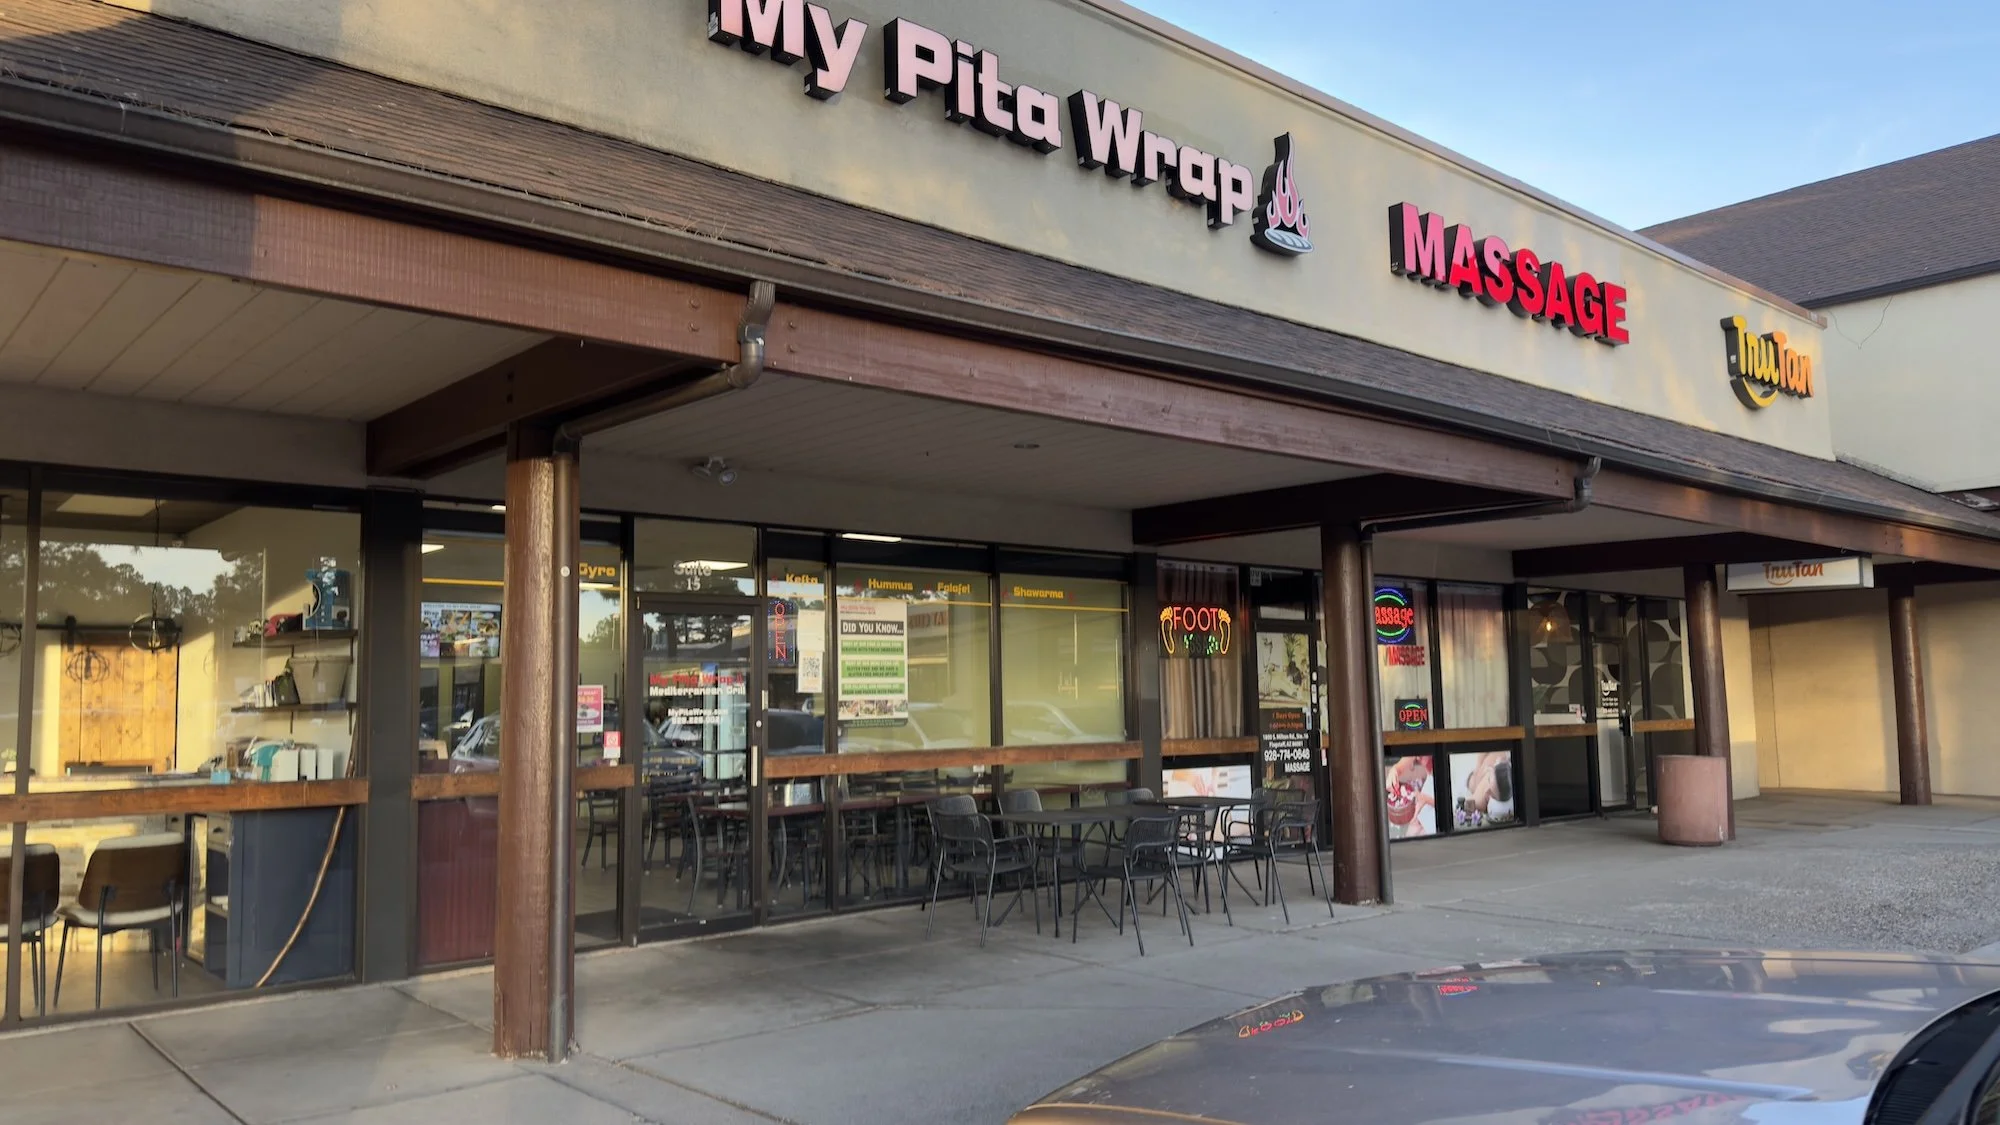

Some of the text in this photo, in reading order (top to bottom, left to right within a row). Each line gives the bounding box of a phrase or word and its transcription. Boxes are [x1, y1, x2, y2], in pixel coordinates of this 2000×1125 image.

[718, 0, 1253, 223] My Pita Wrap
[1398, 202, 1629, 344] MASSAGE
[579, 562, 616, 579] Gyro
[673, 560, 712, 576] Suite
[1762, 560, 1824, 581] TruTan
[687, 576, 701, 591] 15
[785, 573, 819, 585] Kefta
[868, 578, 913, 591] Hummus
[937, 582, 971, 595] Falafel
[1013, 586, 1064, 599] Shawarma
[1173, 606, 1218, 632] FOOT
[1375, 606, 1414, 628] assage
[775, 602, 787, 660] OPEN
[842, 621, 857, 633] DID
[859, 621, 874, 634] YOU
[649, 686, 723, 698] Mediterranean
[1399, 709, 1428, 722] OPEN
[1284, 761, 1310, 772] MASSAGE
